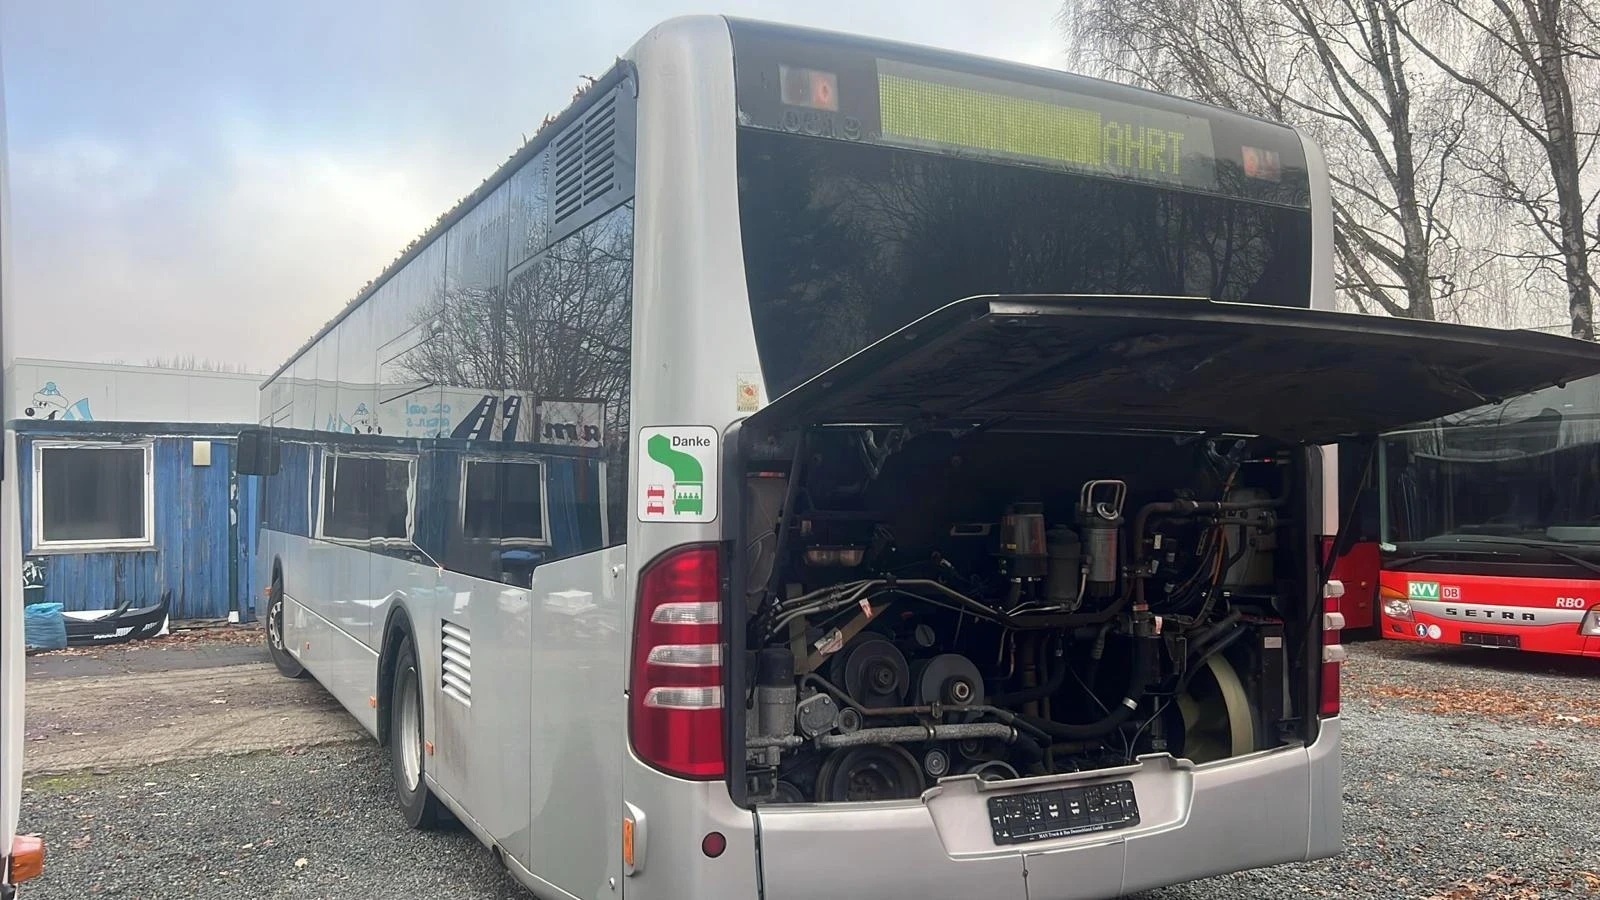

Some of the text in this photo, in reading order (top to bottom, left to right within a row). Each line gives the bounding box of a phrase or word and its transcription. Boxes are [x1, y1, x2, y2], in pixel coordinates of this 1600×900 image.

[1103, 121, 1184, 175] AHRT
[672, 436, 711, 447] Danke
[1409, 583, 1438, 597] RVV
[1444, 588, 1458, 598] DB
[1556, 597, 1585, 608] RBO
[1446, 608, 1535, 621] SETRA
